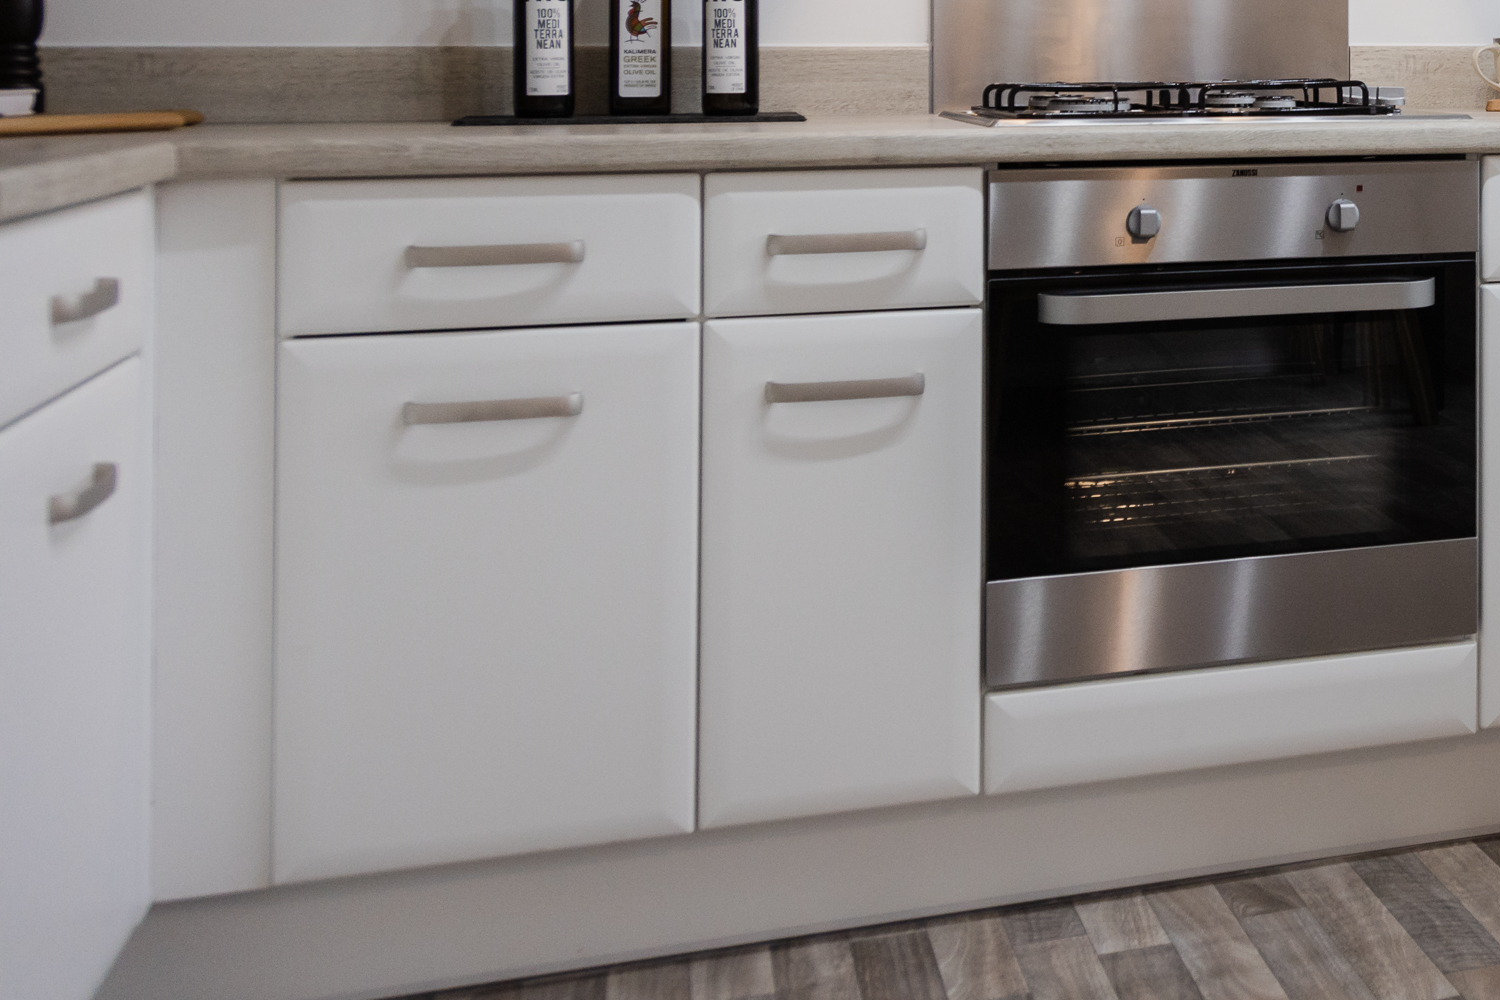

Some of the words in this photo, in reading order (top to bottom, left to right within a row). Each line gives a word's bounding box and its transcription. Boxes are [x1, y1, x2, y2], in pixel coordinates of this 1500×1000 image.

[537, 8, 561, 18] 100%
[714, 8, 736, 18] 100%
[538, 19, 560, 29] MEDI
[714, 19, 735, 28] MEDI
[534, 29, 563, 39] TERRA
[711, 29, 739, 38] TERRA
[536, 40, 561, 49] NEAN
[713, 39, 737, 48] NEAN
[1232, 169, 1258, 177] ZANUSSI
